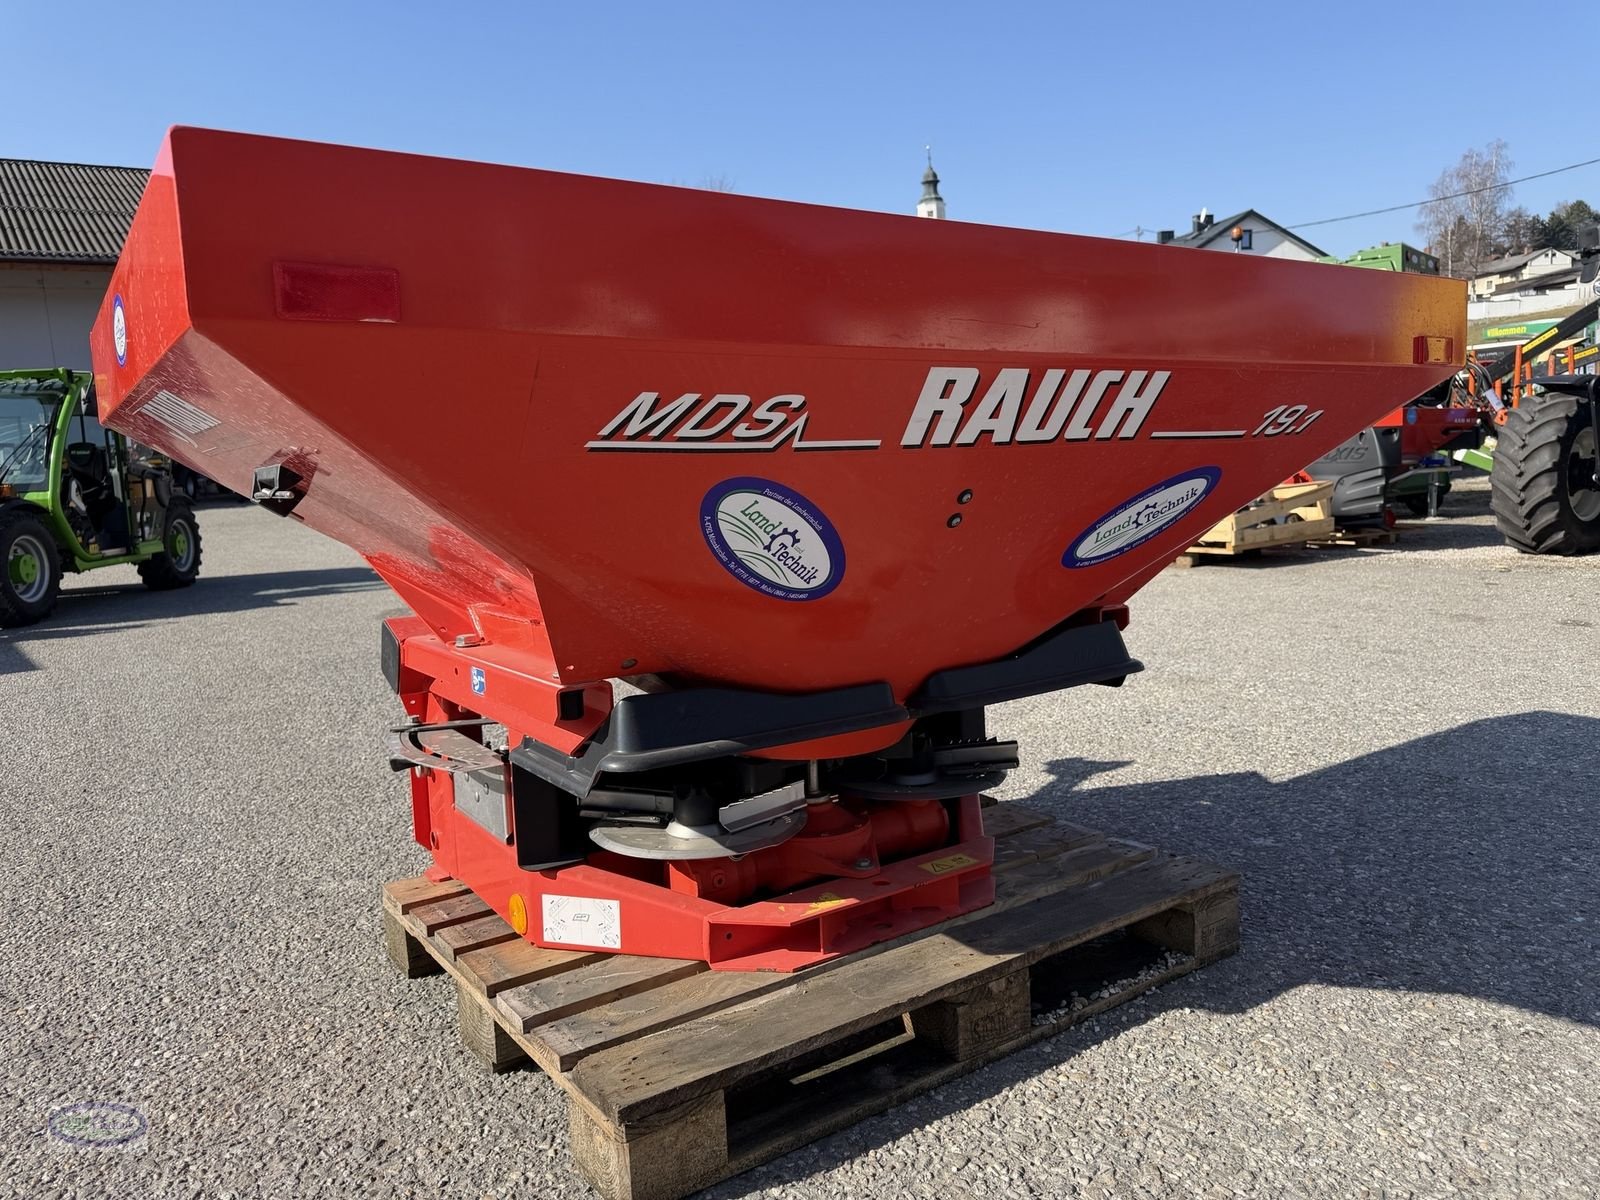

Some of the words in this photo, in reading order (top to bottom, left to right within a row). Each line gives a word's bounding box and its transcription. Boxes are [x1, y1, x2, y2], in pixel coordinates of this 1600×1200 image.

[597, 392, 807, 441] MDS
[900, 366, 1172, 447] RAUCH
[1251, 404, 1325, 437] 19.1
[740, 500, 783, 536] Land
[1143, 487, 1199, 524] Technik
[1094, 515, 1132, 544] Land
[771, 542, 819, 585] Technik
